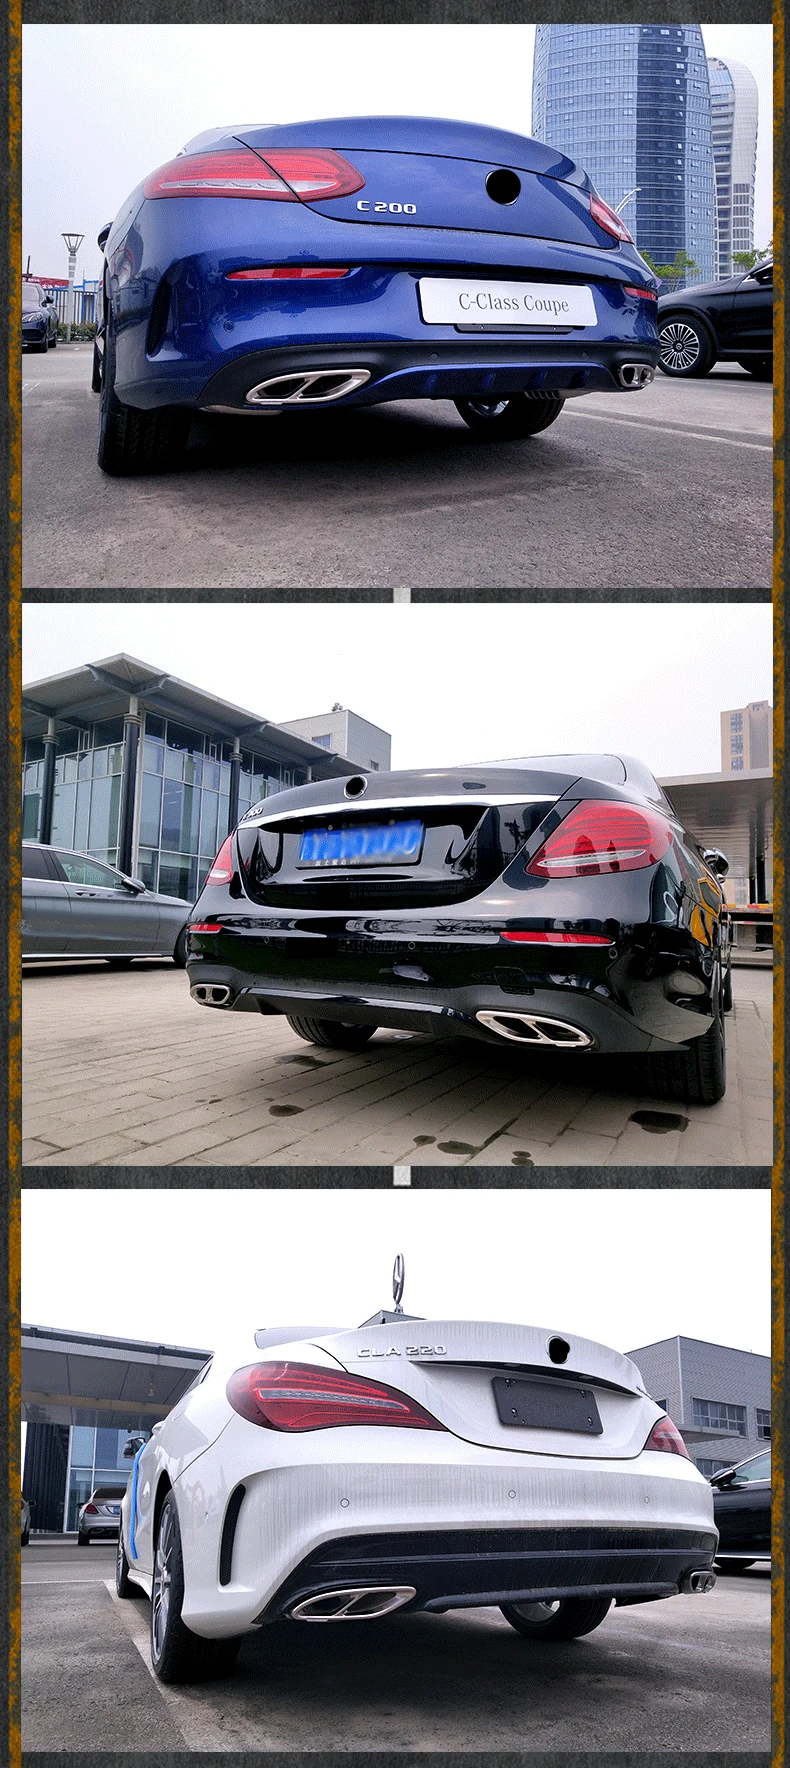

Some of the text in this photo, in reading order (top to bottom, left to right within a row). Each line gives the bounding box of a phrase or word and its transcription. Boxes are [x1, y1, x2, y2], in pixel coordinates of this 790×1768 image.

[356, 200, 417, 215] C 200
[458, 292, 570, 316] C-Class Coupe
[357, 1344, 447, 1358] CLA 220
